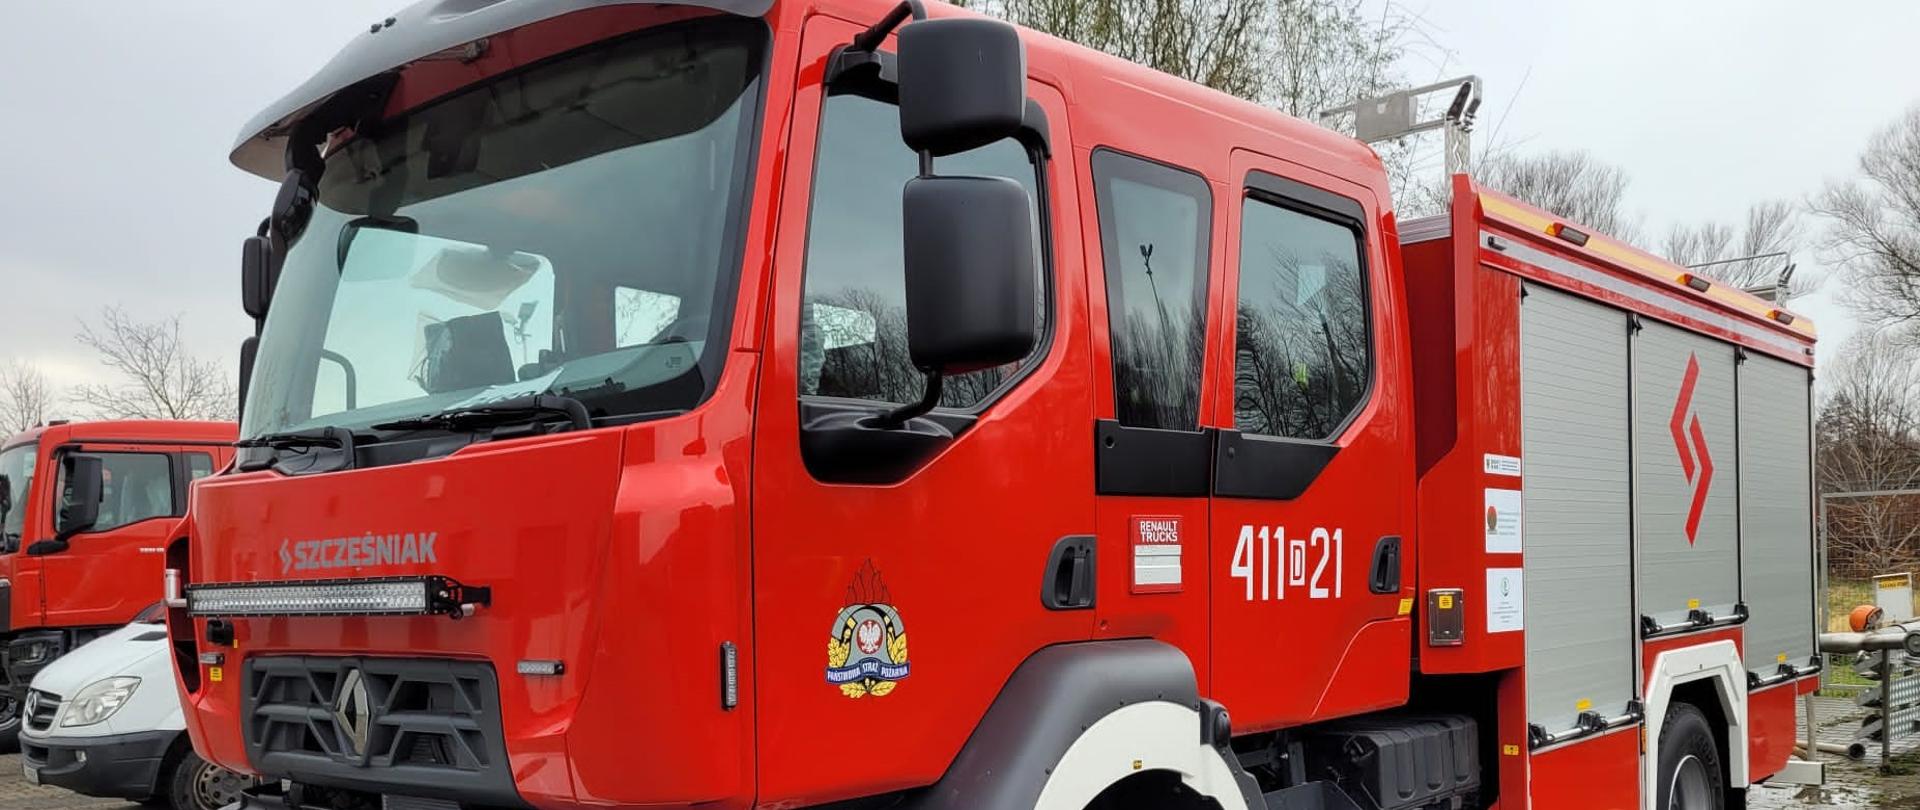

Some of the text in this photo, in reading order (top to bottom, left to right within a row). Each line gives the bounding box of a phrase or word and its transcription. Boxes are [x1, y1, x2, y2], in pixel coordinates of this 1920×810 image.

[1140, 520, 1178, 532] RENAULT
[1141, 531, 1178, 542] TRUCKS
[294, 532, 437, 571] SZCZEŚNIAK
